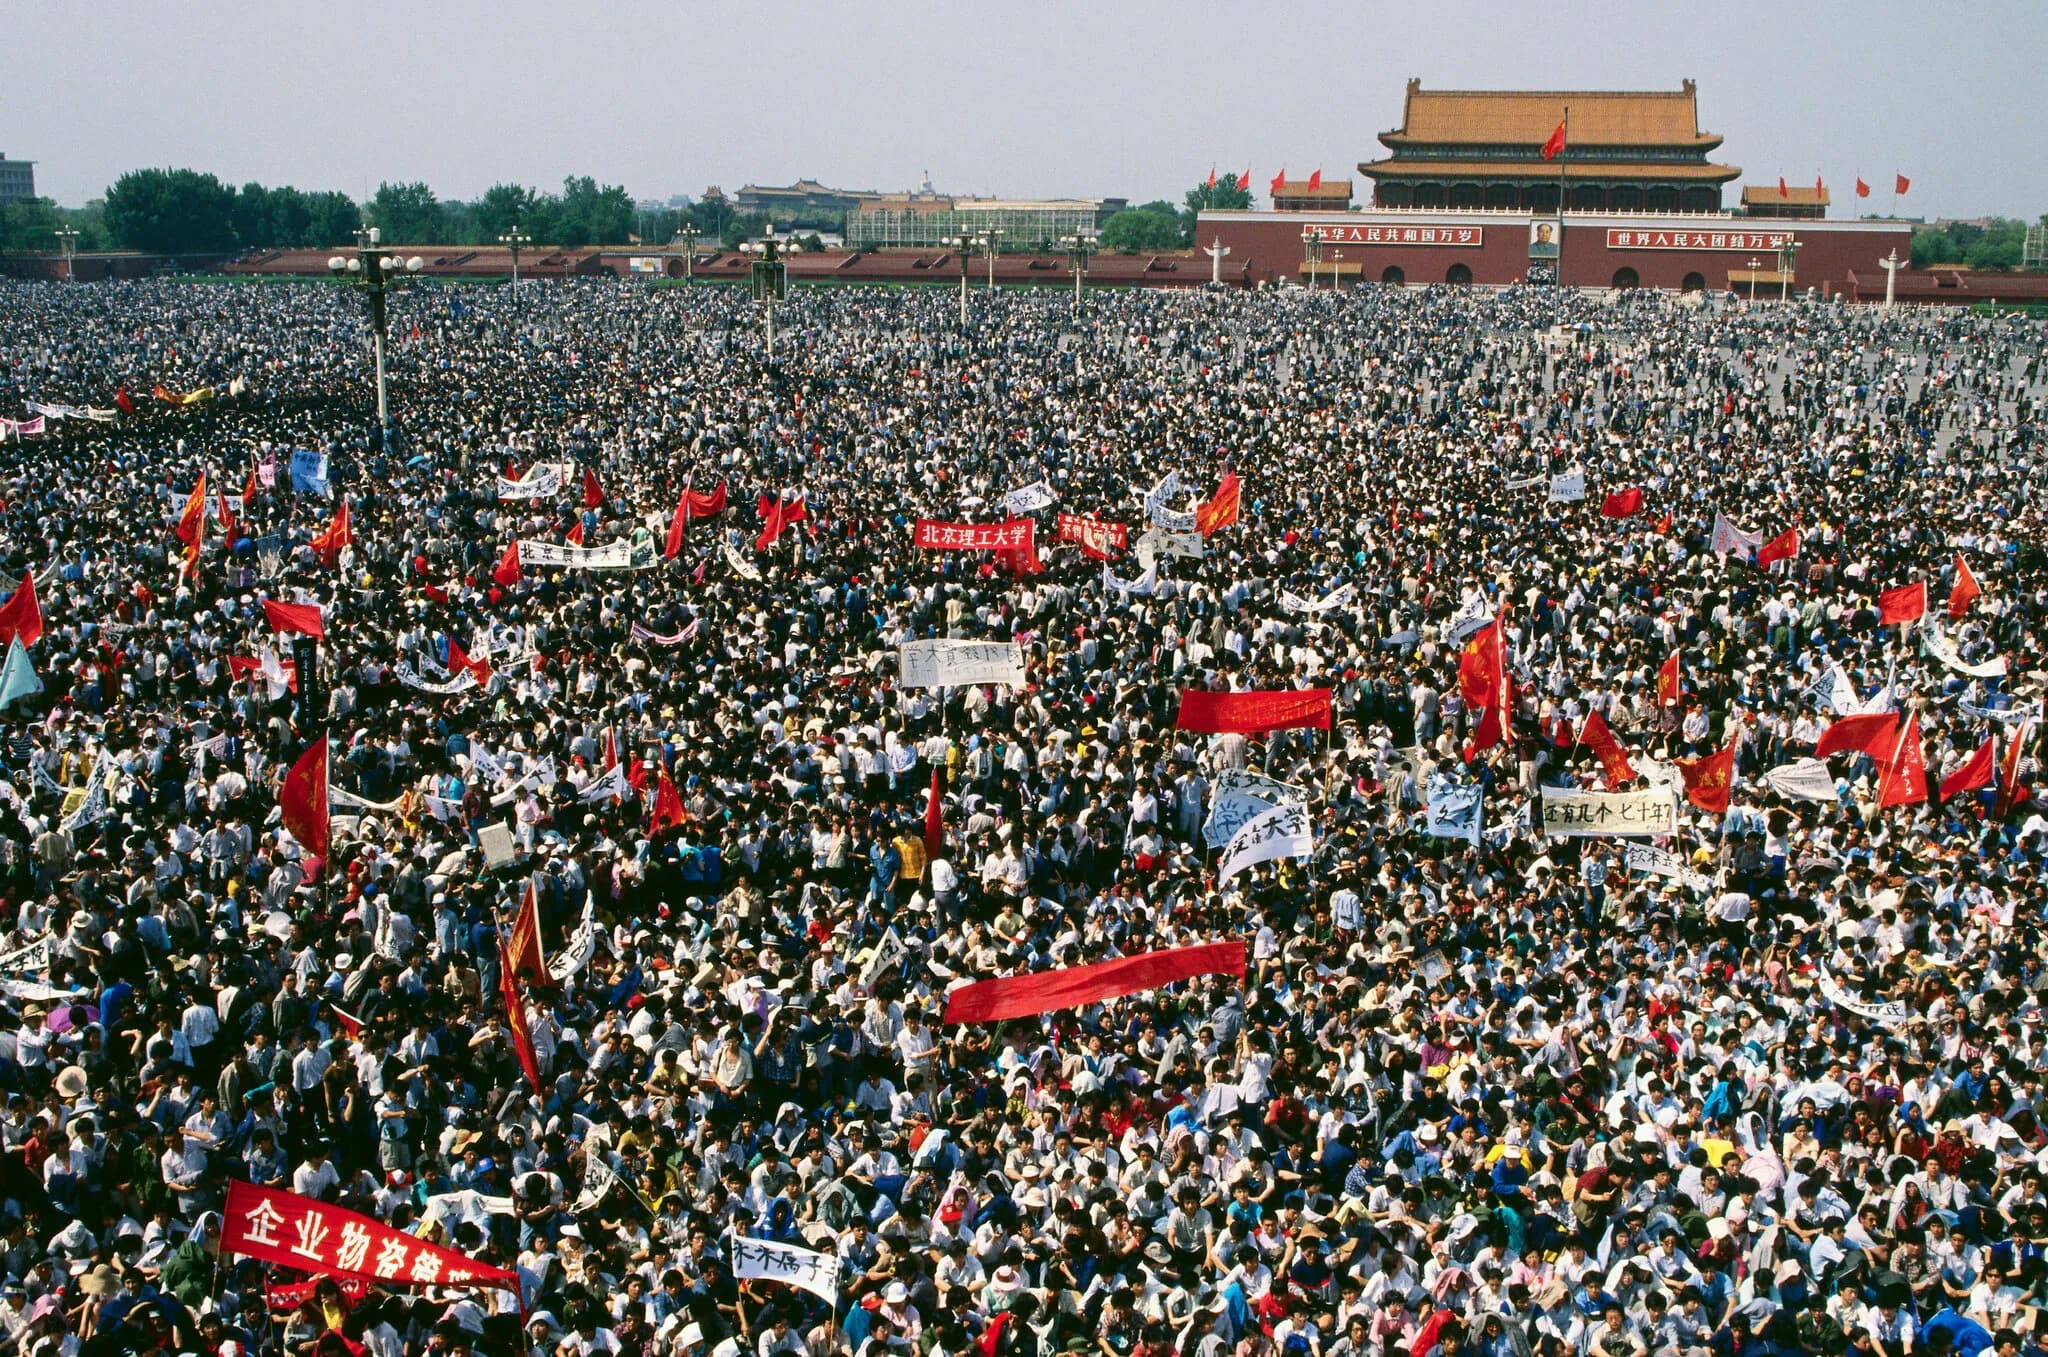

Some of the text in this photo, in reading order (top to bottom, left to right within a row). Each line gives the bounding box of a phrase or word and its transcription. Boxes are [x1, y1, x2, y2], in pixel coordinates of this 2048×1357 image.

[1618, 232, 1784, 249] 世界人民大团结万岁
[922, 525, 1026, 546] 北京理工大学
